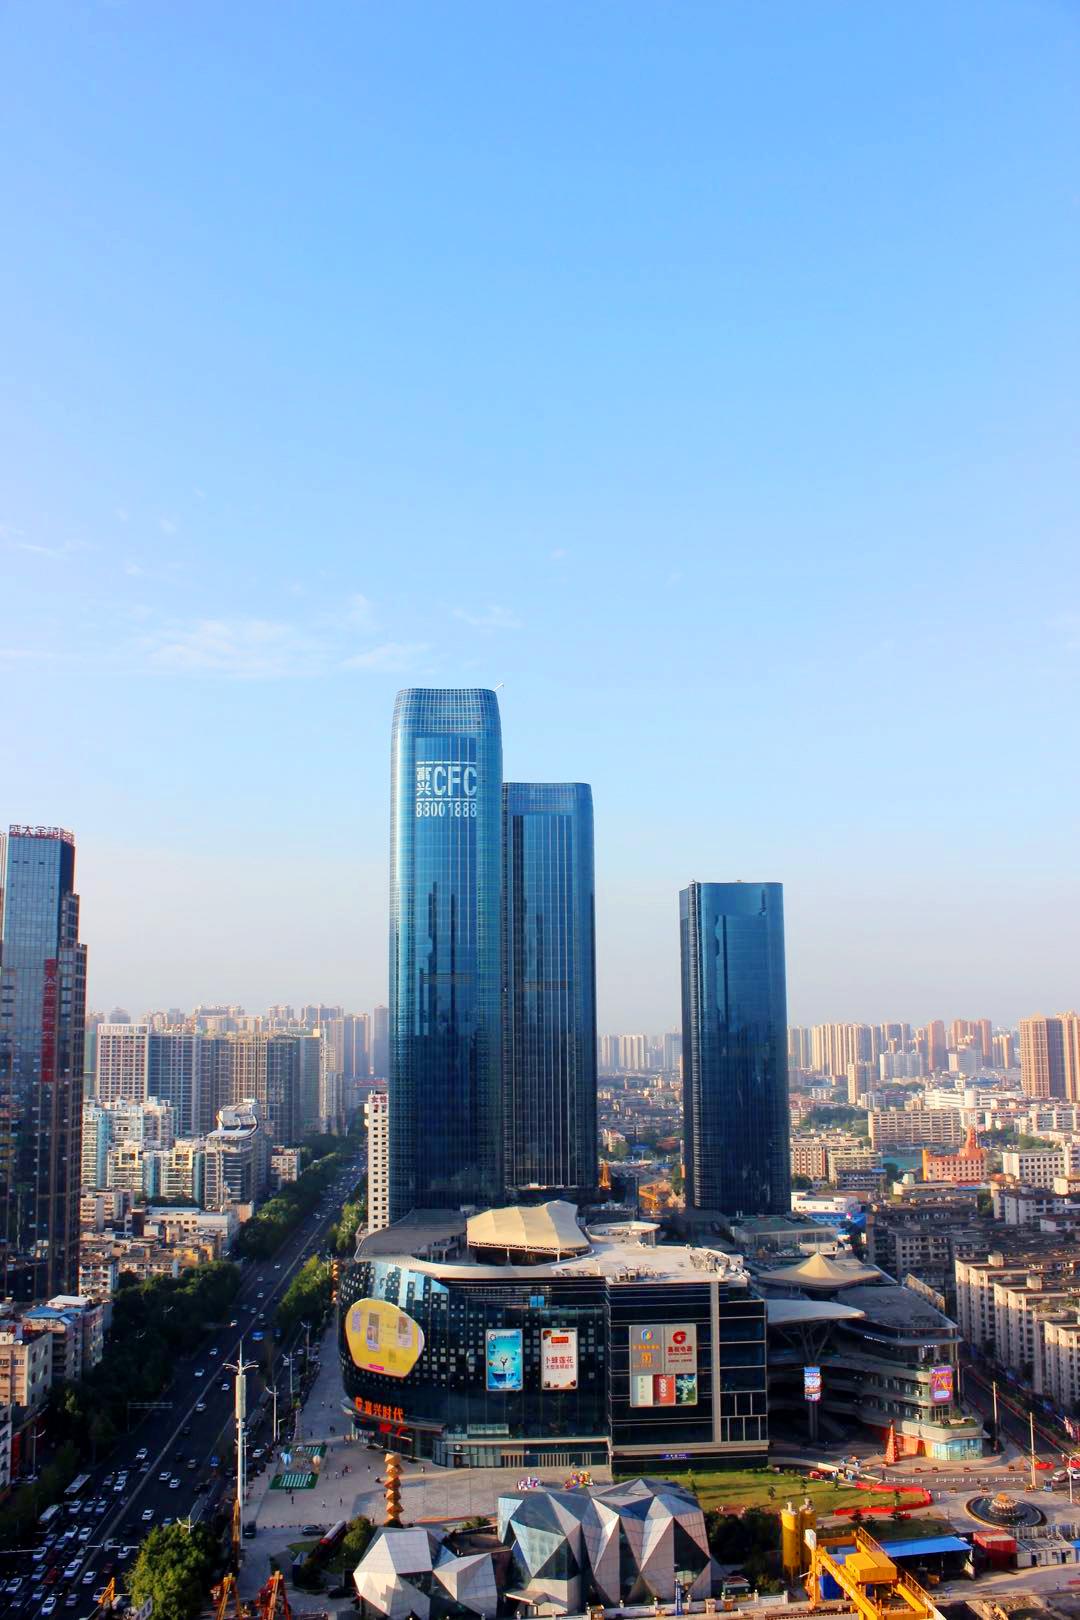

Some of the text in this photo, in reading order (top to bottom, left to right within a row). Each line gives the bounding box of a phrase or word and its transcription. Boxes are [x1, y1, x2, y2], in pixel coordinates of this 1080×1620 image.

[433, 766, 477, 796] CFC
[447, 801, 477, 818] 1888
[545, 1356, 574, 1364] 卜蜂莲花
